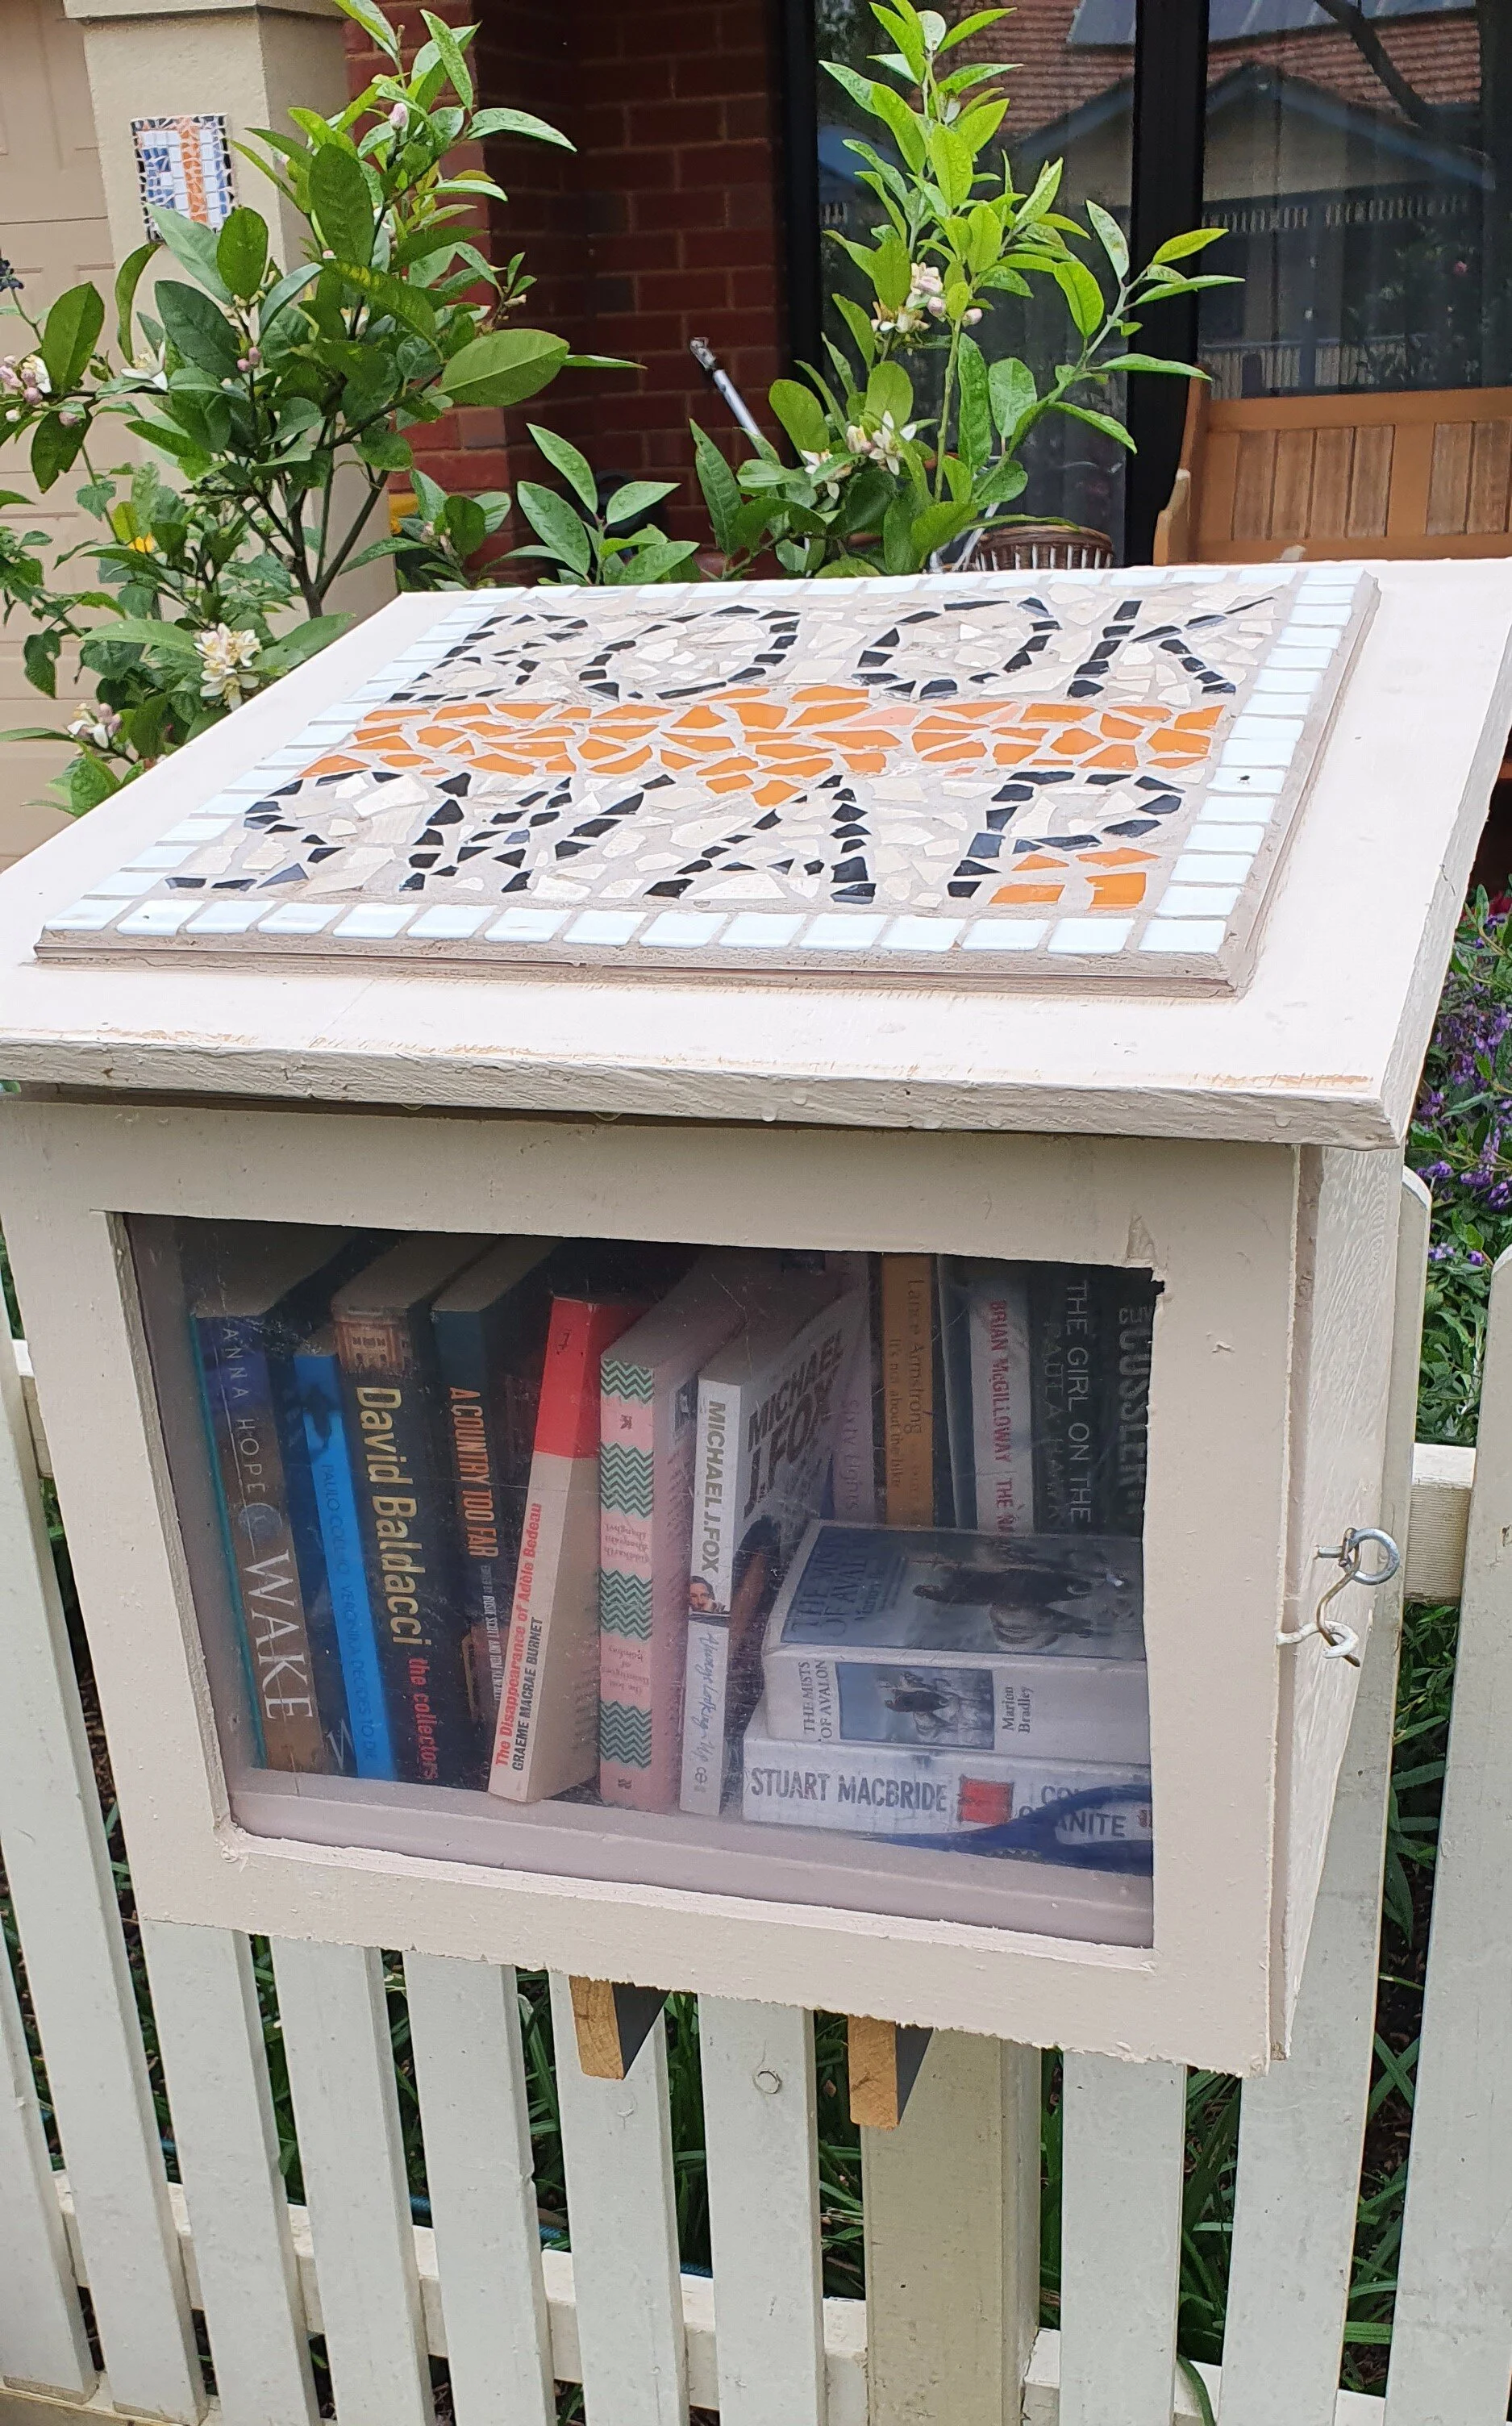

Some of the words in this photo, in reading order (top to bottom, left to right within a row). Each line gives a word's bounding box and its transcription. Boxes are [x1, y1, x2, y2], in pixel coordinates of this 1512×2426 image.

[387, 595, 1276, 702] BOOK
[166, 769, 1182, 904] SWAP
[990, 1298, 1008, 1351] BRIAN
[1067, 1280, 1089, 1335] THE
[449, 1387, 481, 1399] A
[748, 1328, 843, 1453] MICHAEL
[904, 1342, 927, 1435] Armstrong
[1068, 1346, 1089, 1412] GIRL
[223, 1328, 249, 1400] ANNA
[237, 1418, 265, 1494] HOPE
[889, 1390, 902, 1429] about
[356, 1387, 414, 1485] David
[451, 1404, 490, 1486] COUNTRY
[704, 1400, 726, 1508] MICHAEL
[1068, 1423, 1090, 1461] ON
[322, 1464, 341, 1511] PAULO
[462, 1490, 494, 1521] TOO
[996, 1478, 1014, 1507] THE
[1069, 1474, 1092, 1524] THE
[466, 1527, 499, 1557] FAR
[523, 1503, 542, 1558] Bedeau
[372, 1495, 432, 1645] Baldacci
[244, 1549, 313, 1720] WAKE
[341, 1583, 361, 1654] VERONIKA
[516, 1604, 527, 1622] of
[526, 1616, 543, 1665] BURNET
[352, 1661, 371, 1715] DECIDES
[408, 1657, 431, 1686] the
[499, 1626, 525, 1736] Disappearance
[519, 1667, 536, 1718] MACRAE
[797, 1661, 814, 1699] MISTS
[814, 1659, 831, 1715] AVALON
[360, 1719, 374, 1736] TO
[691, 1682, 719, 1732] Looking
[802, 1703, 815, 1734] THE
[819, 1717, 832, 1739] OF
[1002, 1686, 1015, 1732] Marion
[1018, 1686, 1034, 1734] Bradley
[364, 1742, 377, 1761] DIE
[413, 1693, 439, 1780] collectors
[496, 1740, 510, 1765] The
[512, 1721, 529, 1771] GRAEME
[750, 1766, 831, 1801] STUART
[837, 1775, 948, 1814] MACBRIDE
